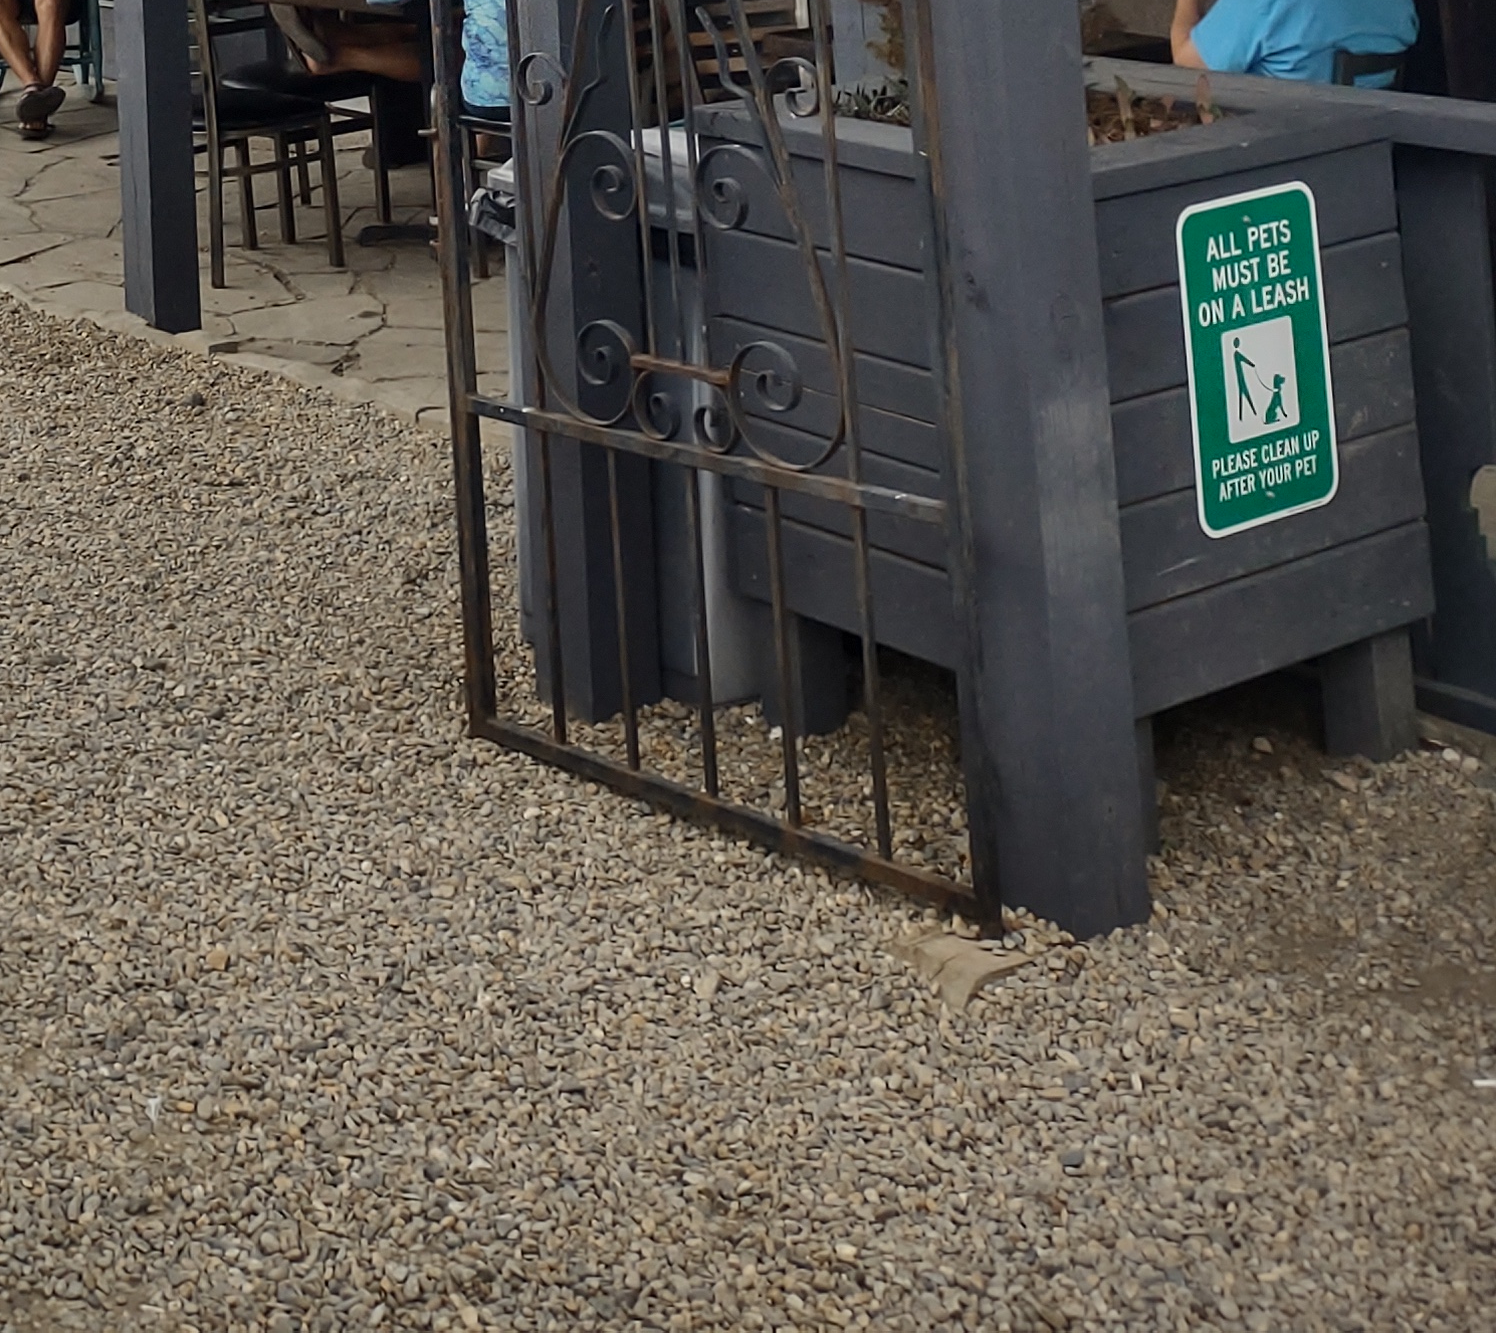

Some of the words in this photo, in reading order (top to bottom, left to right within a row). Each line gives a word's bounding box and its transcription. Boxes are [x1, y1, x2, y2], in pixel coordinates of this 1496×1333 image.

[1206, 232, 1242, 262] ALL
[1247, 220, 1291, 252] PETS
[1212, 257, 1260, 293] MUST
[1267, 250, 1291, 278] BE
[1198, 298, 1224, 327] ON
[1232, 293, 1245, 319] A
[1251, 276, 1310, 315] LEASH
[1212, 446, 1258, 479] PLEASE
[1261, 435, 1300, 463] CLEAN
[1303, 430, 1320, 452] UP
[1219, 474, 1256, 502] AFTER
[1259, 461, 1292, 490] YOUR
[1296, 454, 1318, 477] PET
